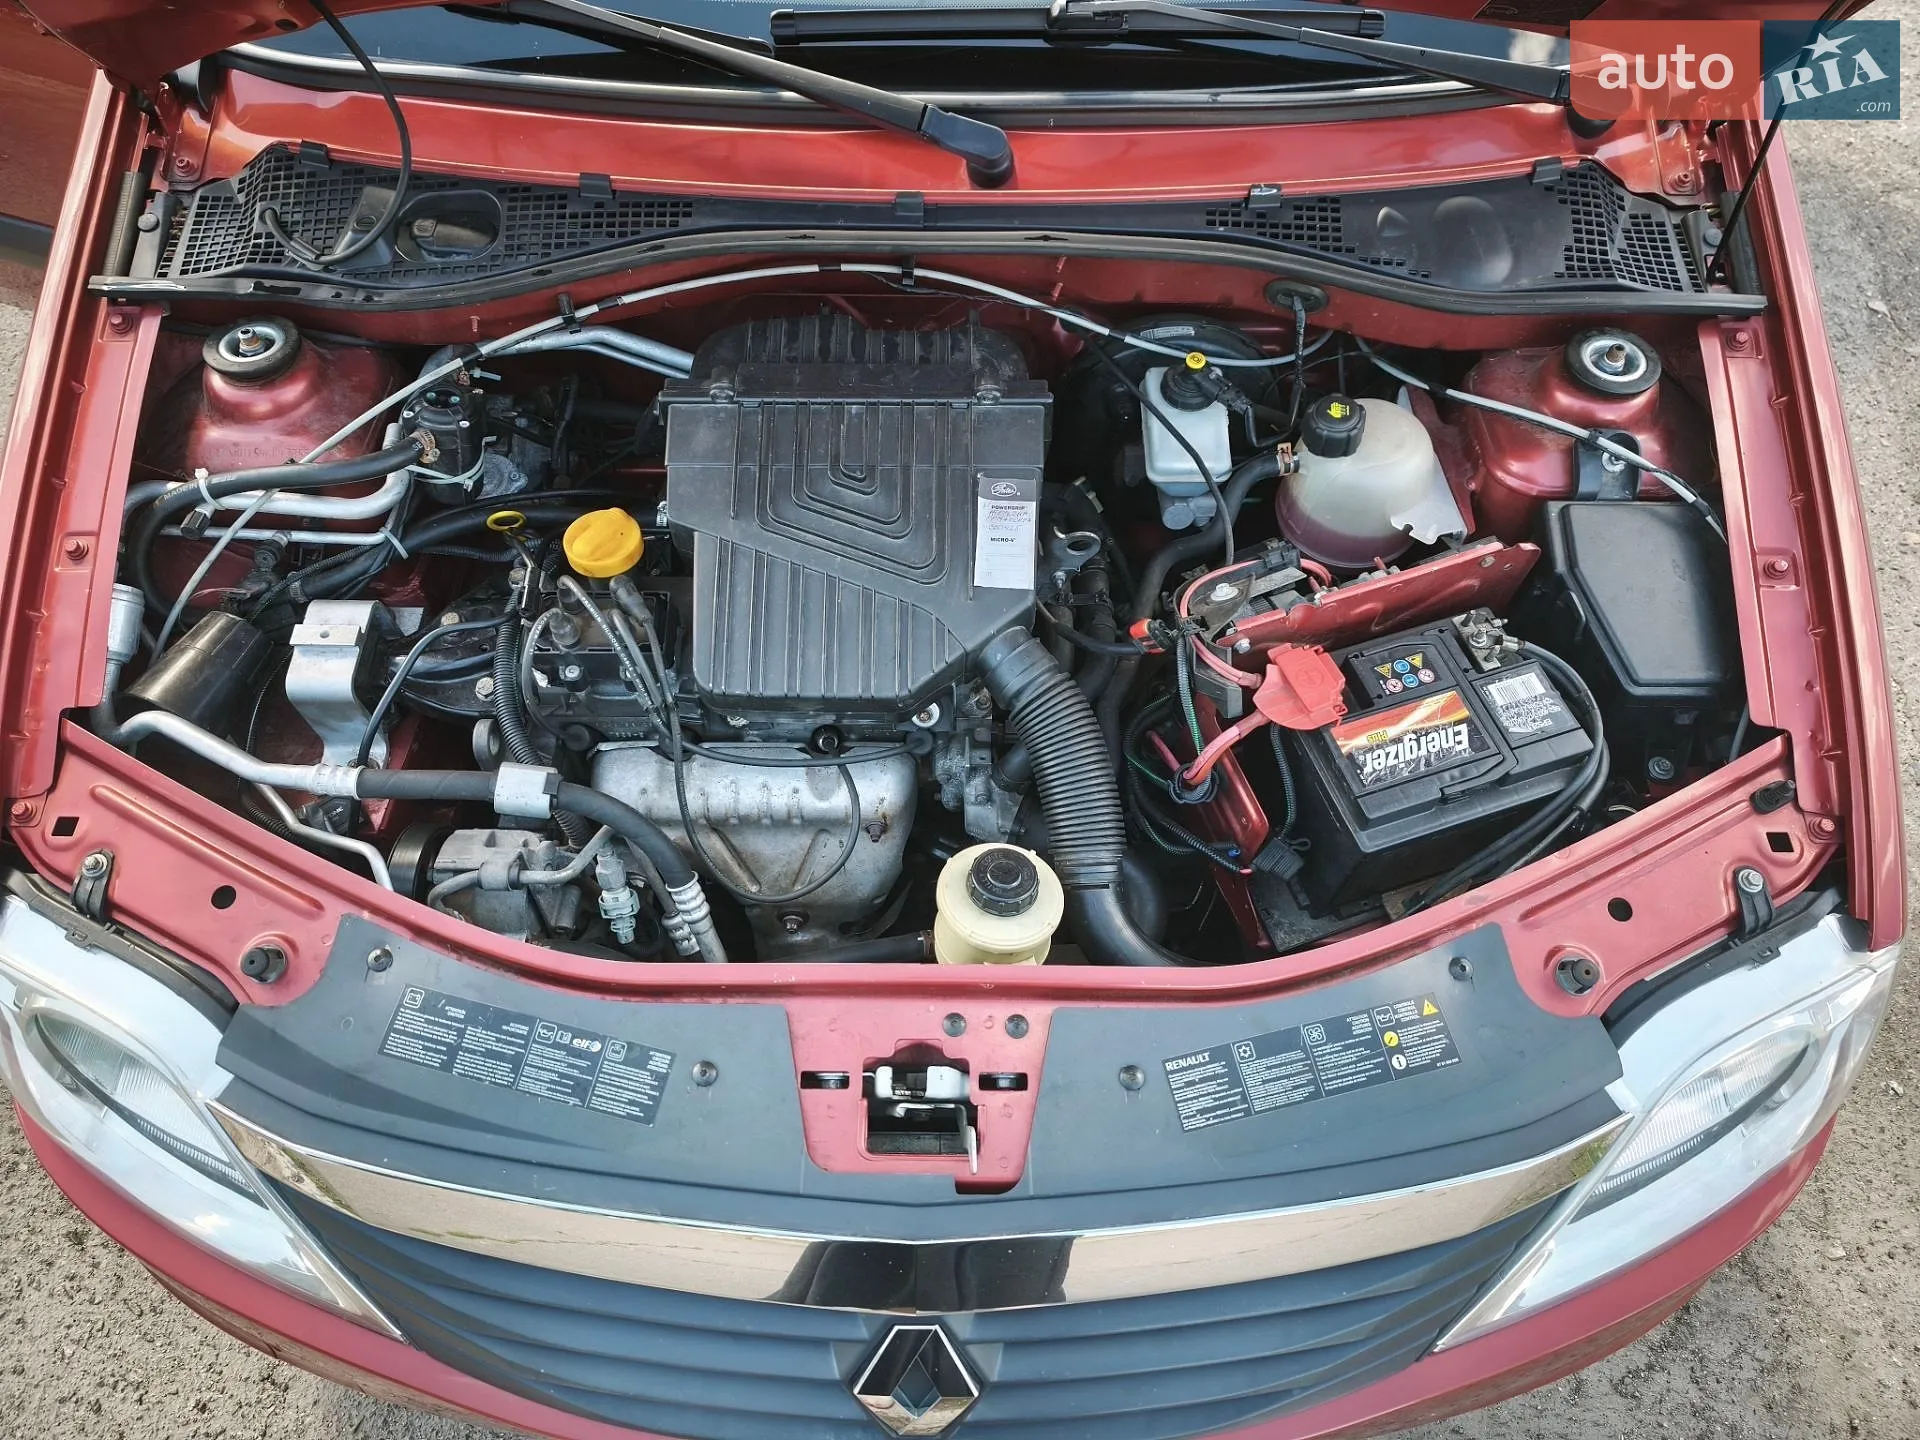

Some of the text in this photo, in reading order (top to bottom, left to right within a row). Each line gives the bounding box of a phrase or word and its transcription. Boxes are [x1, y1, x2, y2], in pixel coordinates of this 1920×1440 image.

[1367, 730, 1388, 744] Plus
[1363, 722, 1470, 775] Energizer
[572, 1038, 591, 1049] elf
[1165, 1052, 1210, 1072] RENAULT
